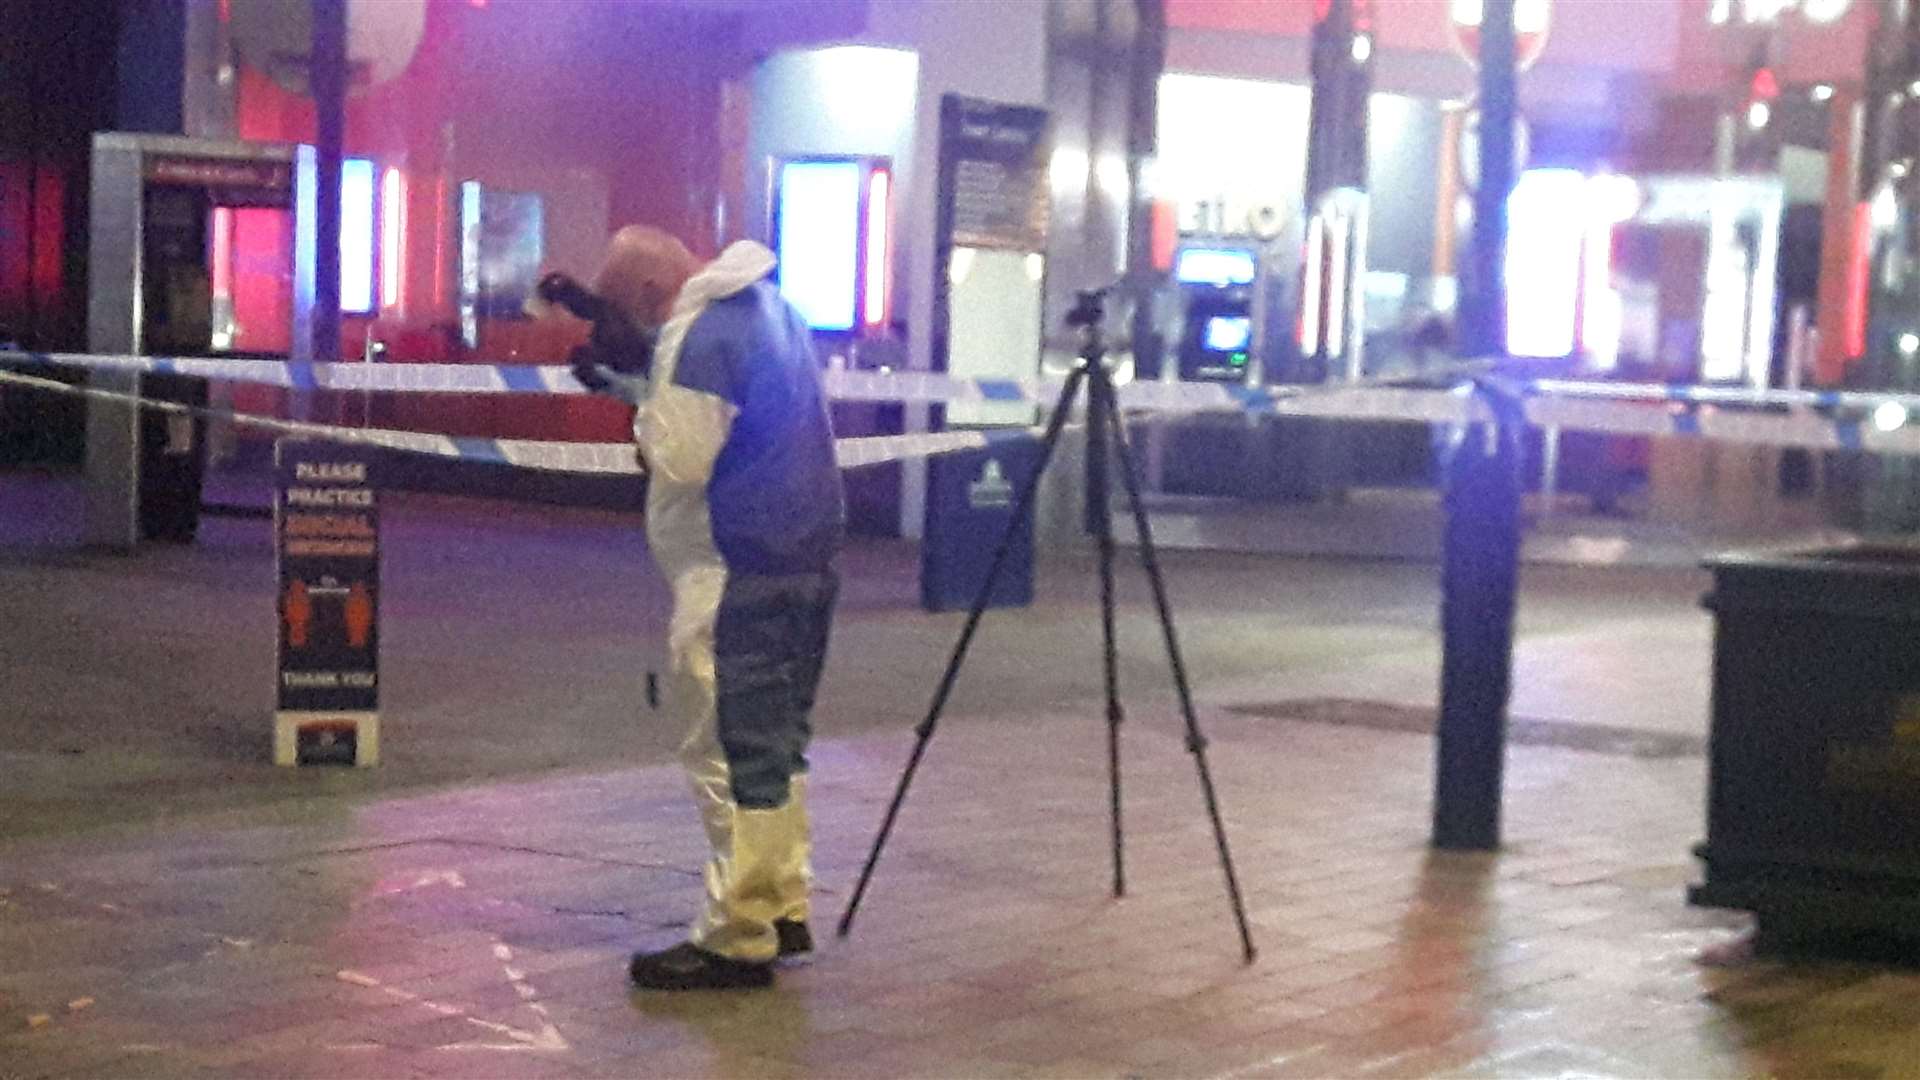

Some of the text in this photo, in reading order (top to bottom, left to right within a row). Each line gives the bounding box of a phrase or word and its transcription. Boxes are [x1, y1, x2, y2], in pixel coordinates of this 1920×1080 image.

[296, 463, 365, 481] PLEASE
[288, 489, 373, 506] PRACTICE
[284, 671, 374, 688] THANK YOU
